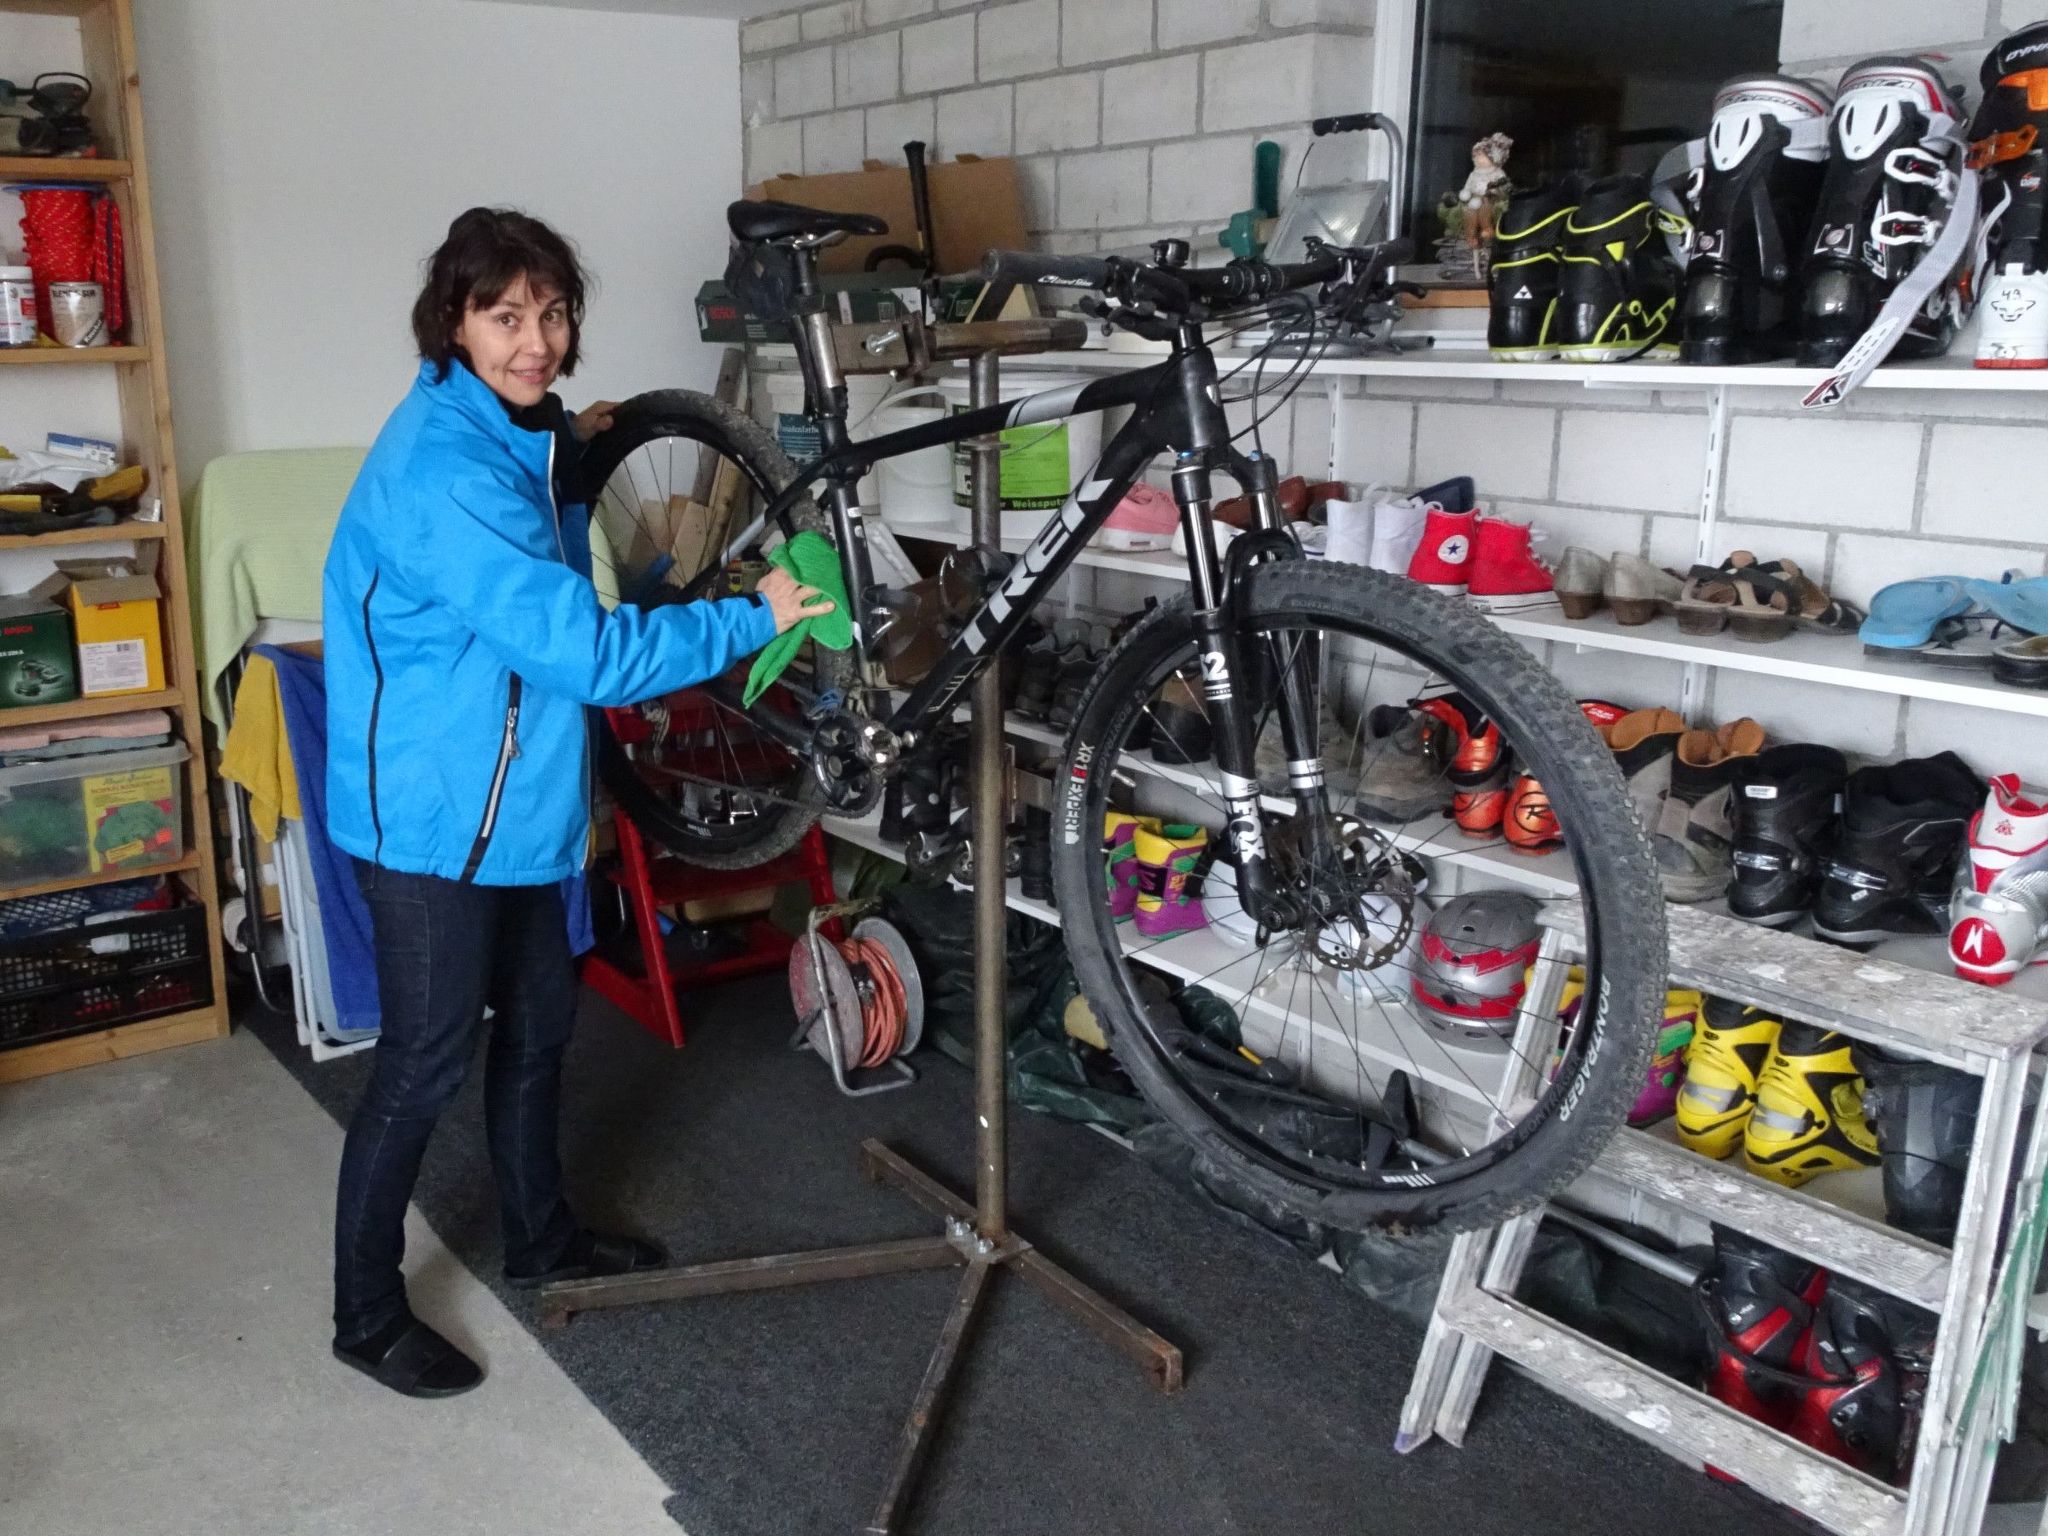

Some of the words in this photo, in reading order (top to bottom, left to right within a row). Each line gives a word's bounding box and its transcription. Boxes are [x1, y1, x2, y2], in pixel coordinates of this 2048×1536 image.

[951, 457, 1114, 656] TREK
[1230, 798, 1267, 863] FOX
[1560, 974, 1611, 1122] BONTRAGER
